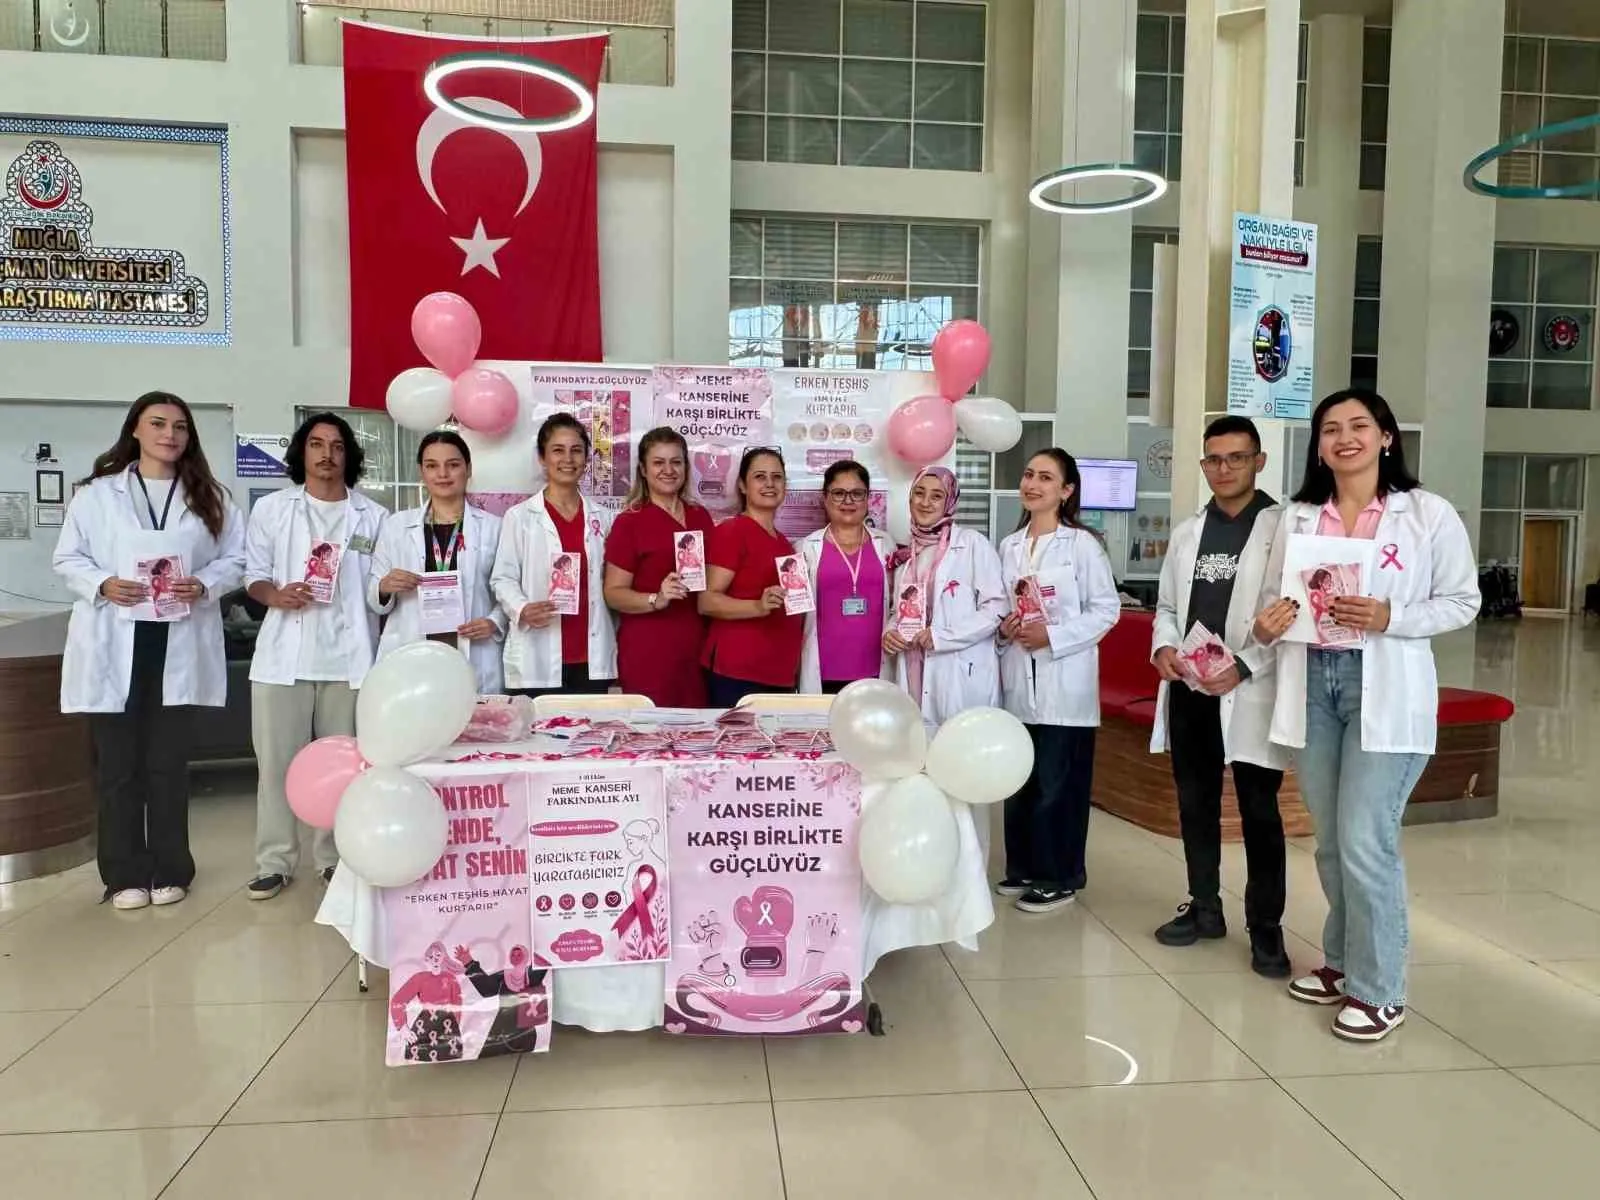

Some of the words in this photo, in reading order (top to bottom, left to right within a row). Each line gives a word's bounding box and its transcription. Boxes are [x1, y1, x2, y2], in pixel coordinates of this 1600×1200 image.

[15, 227, 79, 249] MUĞLA
[1238, 219, 1271, 235] ORGAN
[1301, 228, 1313, 241] VE
[52, 255, 171, 282] ÜNİVERSİTESİ
[99, 289, 194, 313] HASTANESİ
[696, 375, 733, 386] MEME
[794, 376, 829, 389] ERKEN
[679, 390, 750, 403] KANSERİNE
[666, 408, 703, 422] KARŞI
[707, 406, 761, 420] BİRLİKTE
[806, 403, 857, 416] KURTARIR
[680, 423, 748, 438] GÜÇLÜYÜZ
[552, 786, 580, 795] MEME
[585, 782, 631, 793] KANSERİ
[736, 776, 796, 792] MEME
[547, 796, 620, 806] FARKINDALIK
[623, 794, 640, 802] AYI
[708, 799, 823, 818] KANSERİNE
[687, 830, 747, 850] KARŞI
[754, 826, 843, 846] BİRLİKTE
[465, 845, 528, 878] SENİN
[709, 854, 821, 878] GÜÇLÜYÜZ
[452, 888, 490, 900] TEŞHİS
[493, 886, 529, 896] HAYAT
